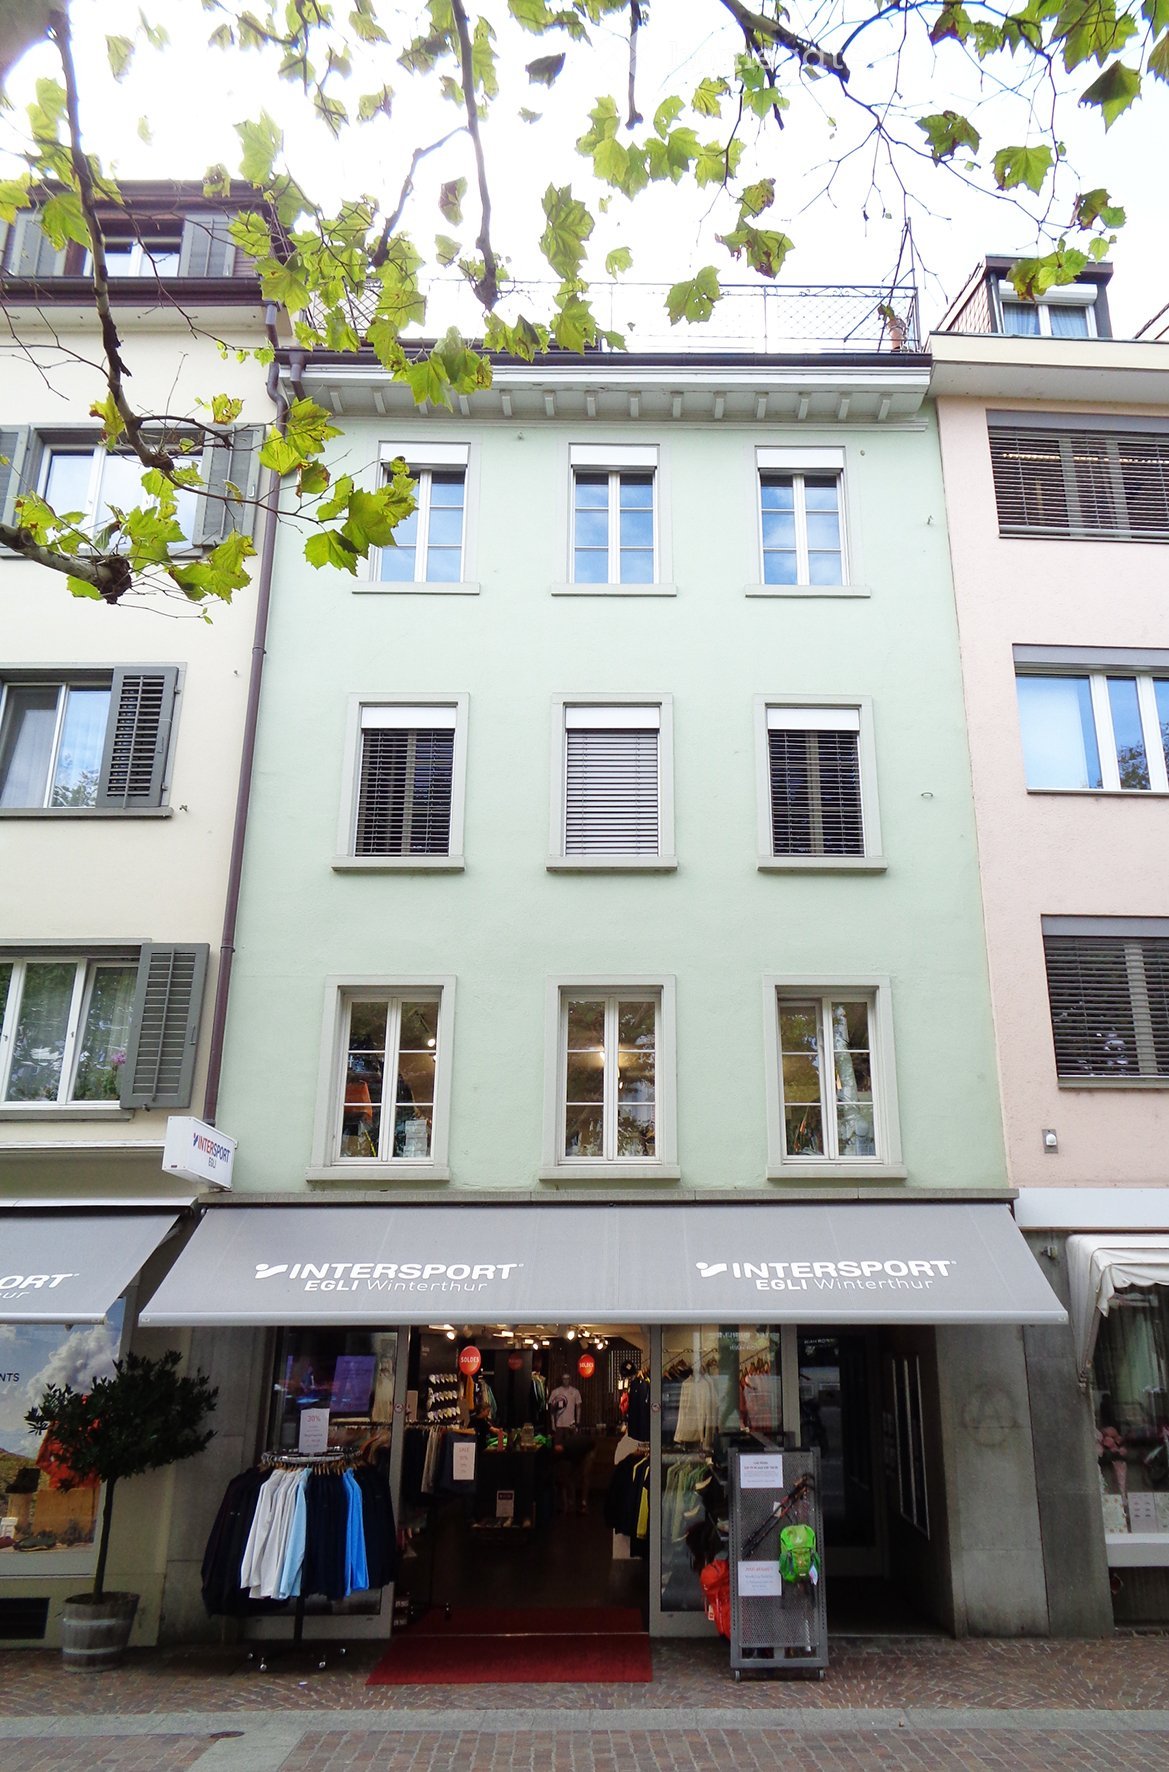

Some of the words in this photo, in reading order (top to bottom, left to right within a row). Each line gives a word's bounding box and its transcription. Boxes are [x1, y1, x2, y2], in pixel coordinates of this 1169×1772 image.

[197, 1135, 231, 1163] INTERSPORT
[289, 1263, 518, 1280] INTERSPORT
[732, 1260, 951, 1278] INTERSPORT
[304, 1280, 358, 1291] EGLI
[366, 1280, 488, 1292] Winterthur
[756, 1279, 808, 1290] EGLI
[813, 1278, 933, 1290] Winterthur
[0, 1291, 31, 1299] ur
